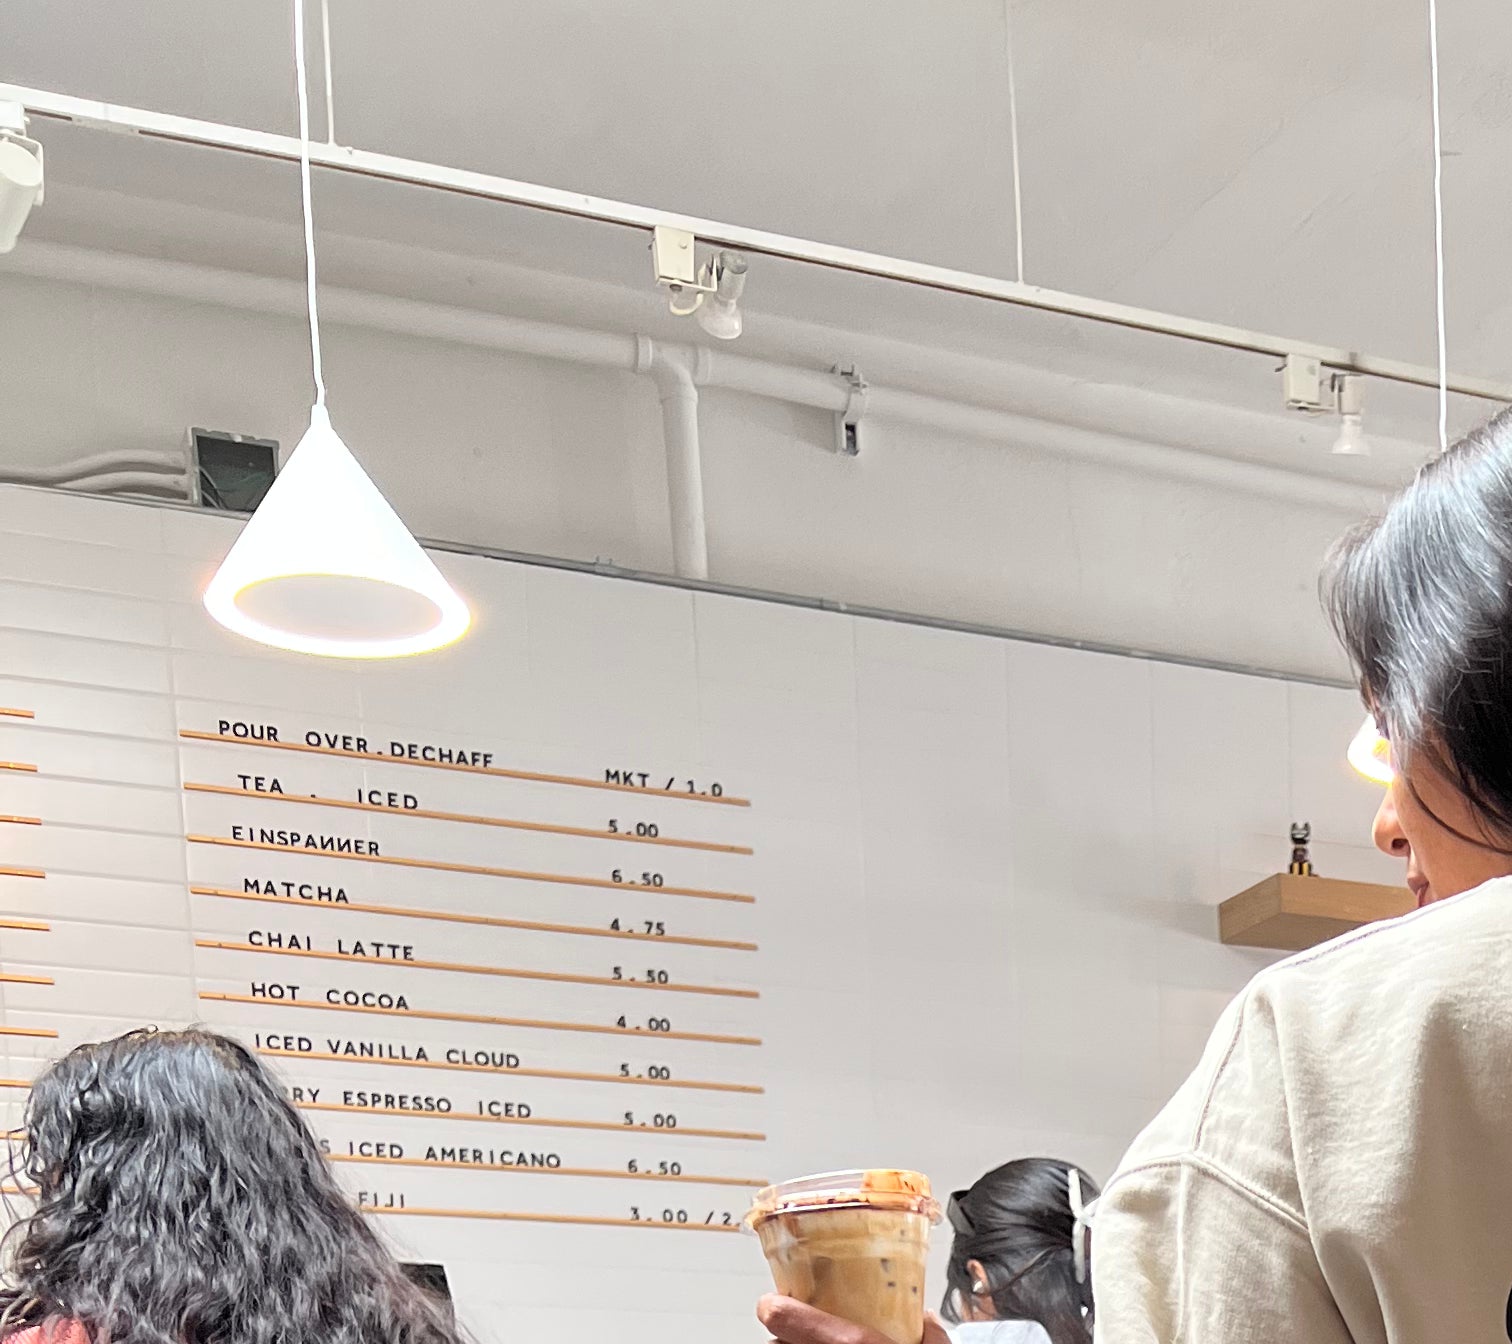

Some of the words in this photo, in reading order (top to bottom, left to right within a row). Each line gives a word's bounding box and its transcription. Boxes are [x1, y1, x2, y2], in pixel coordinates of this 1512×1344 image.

[218, 719, 279, 743] POUR
[605, 768, 650, 788] MKT
[237, 774, 284, 795] TEA
[357, 788, 418, 810] ICED
[244, 878, 349, 904] MATCHA
[248, 930, 311, 952] CHAI
[337, 939, 414, 962] LATTE
[251, 982, 300, 1001] HOT
[326, 989, 409, 1010] COCOA
[255, 1033, 313, 1052] ICED
[326, 1039, 428, 1062] VANILLA
[446, 1048, 520, 1069] CLOUD
[343, 1090, 452, 1113] ESPRESSO
[478, 1100, 532, 1119] ICED
[349, 1141, 404, 1159] ICED
[425, 1146, 561, 1169] AMERICANO
